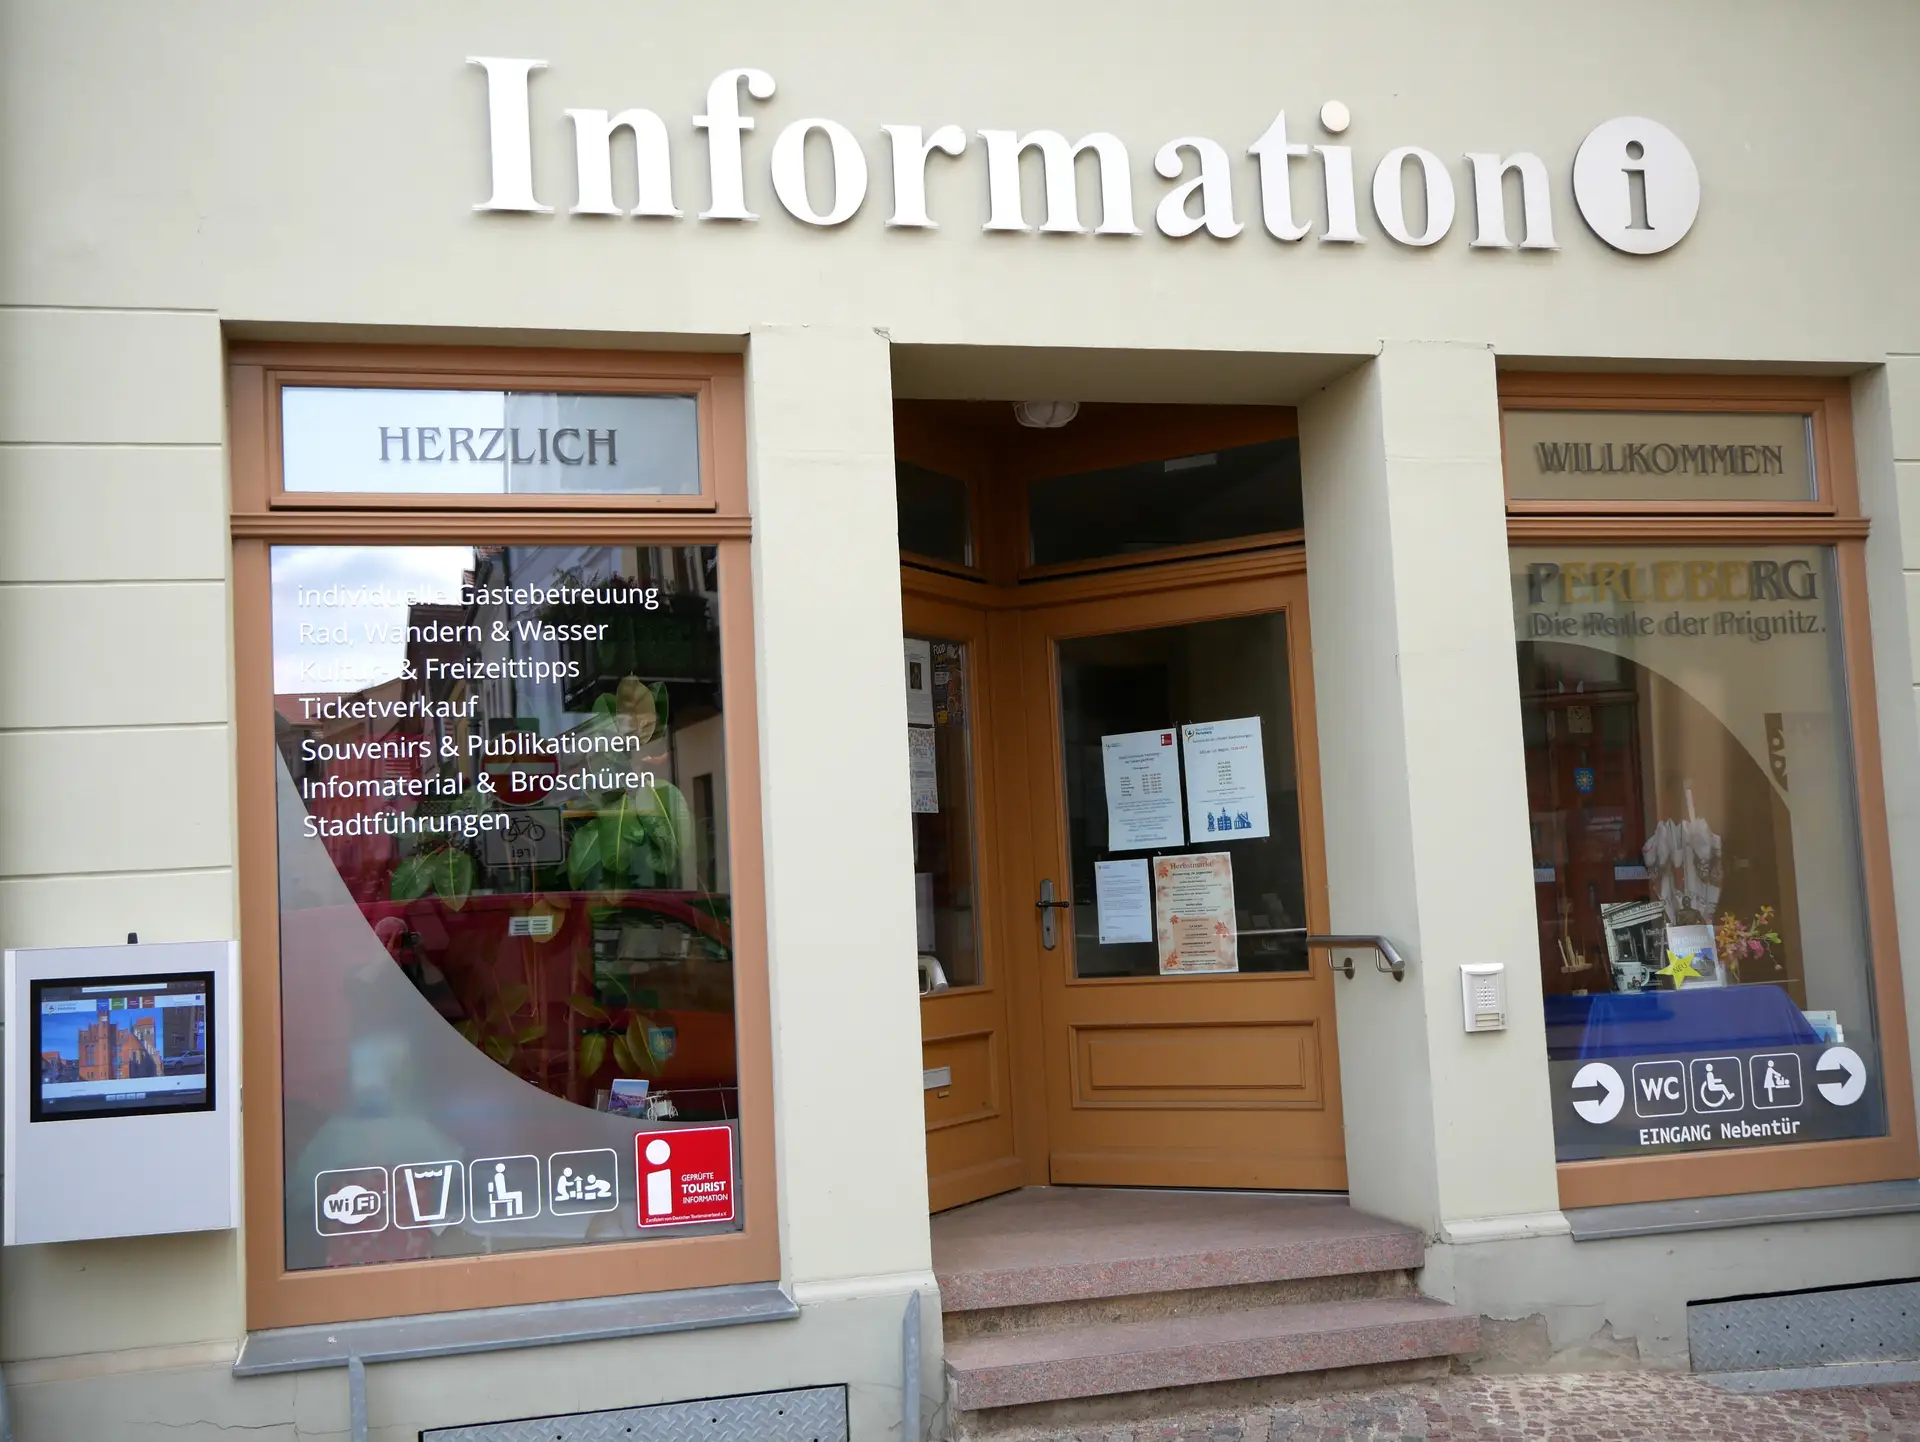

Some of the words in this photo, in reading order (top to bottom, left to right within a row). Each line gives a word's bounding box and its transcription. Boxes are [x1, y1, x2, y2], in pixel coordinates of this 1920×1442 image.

[465, 56, 1562, 252] Information
[378, 425, 619, 466] HERZLICH
[1537, 441, 1785, 475] WILLKOMMEN
[1528, 559, 1819, 604] PERLEBERG
[297, 583, 448, 609] individuelle
[458, 583, 660, 610] Gästebetreuung
[299, 621, 356, 648] Rad,
[365, 620, 483, 645] Wandern
[490, 621, 511, 642] &
[517, 620, 609, 643] Wasser
[1532, 612, 1578, 637] Die
[1664, 610, 1710, 636] der
[1719, 609, 1826, 642] Prignitz.
[400, 658, 418, 680] &
[425, 656, 580, 685] Freizeittipps
[299, 694, 479, 721] Ticketverkauf
[301, 736, 432, 762] Souvenirs
[440, 737, 459, 758] &
[467, 732, 641, 757] Publikationen
[302, 772, 464, 800] Infomaterial
[477, 774, 496, 795] &
[511, 768, 655, 793] Broschüren
[302, 808, 510, 839] Stadtführungen
[1672, 962, 1688, 974] NEU
[1640, 1076, 1680, 1102] WC
[1639, 1123, 1711, 1146] EINGANG
[1720, 1118, 1800, 1140] Nebentür
[681, 1171, 714, 1182] GEPRÜFTE
[681, 1181, 727, 1195] TOURIST
[682, 1193, 729, 1204] INFORMATION
